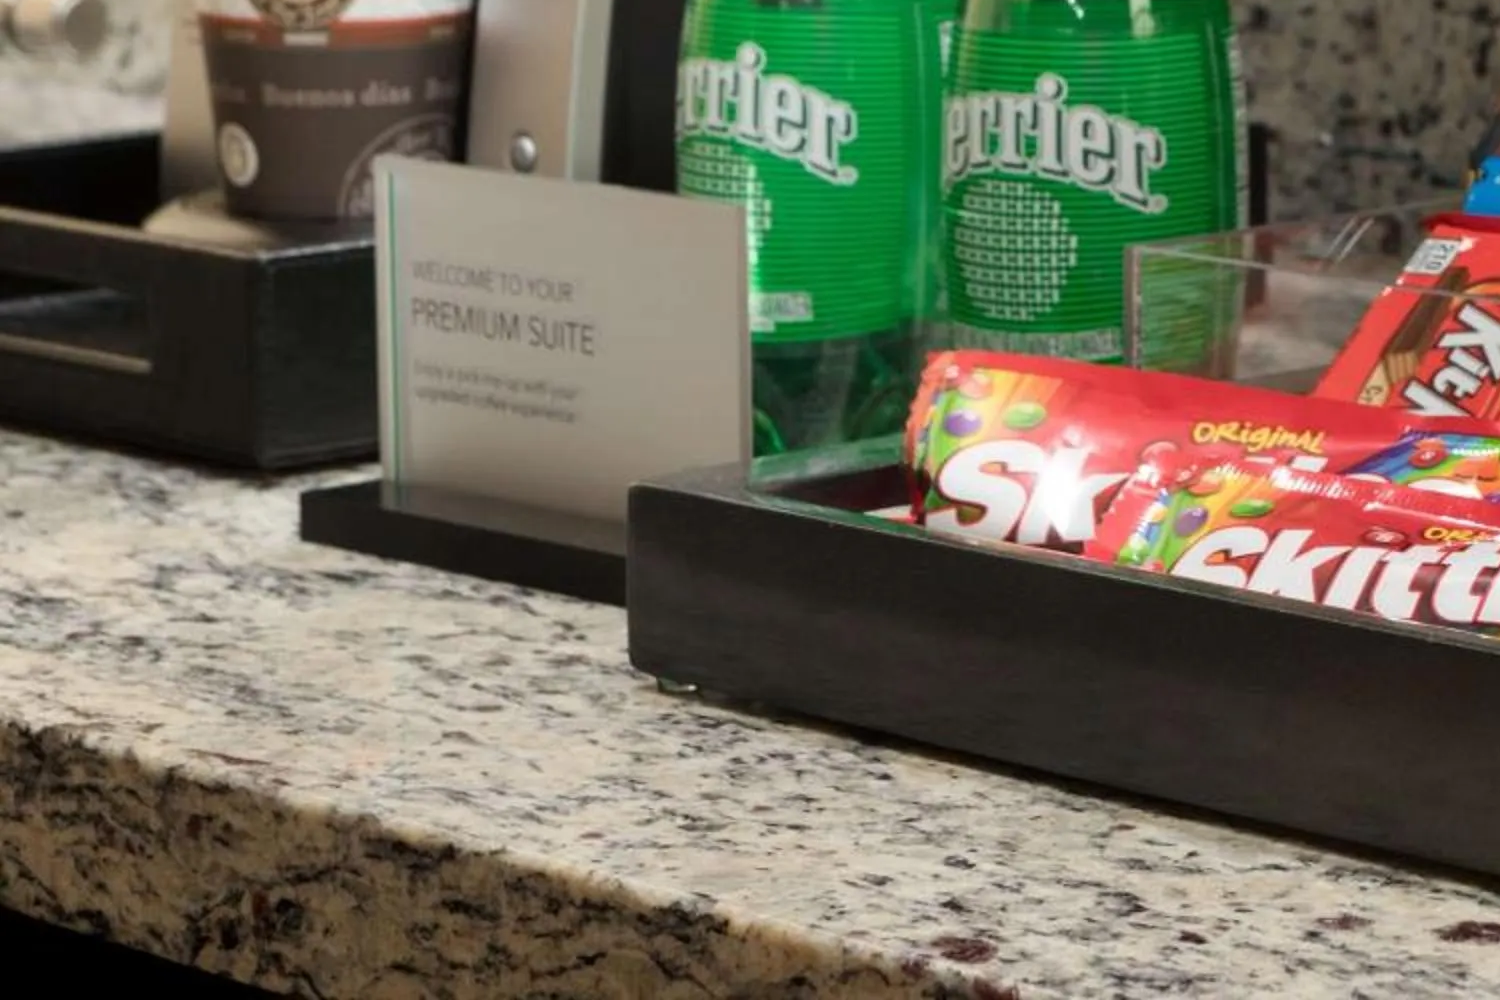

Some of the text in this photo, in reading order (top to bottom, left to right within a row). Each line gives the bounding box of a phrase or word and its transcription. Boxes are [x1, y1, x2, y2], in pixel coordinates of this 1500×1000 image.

[677, 41, 855, 178] rrier
[945, 73, 1164, 209] errier
[411, 297, 596, 357] PREMIUM SUITE
[412, 261, 575, 304] WELCOME TO YOUR
